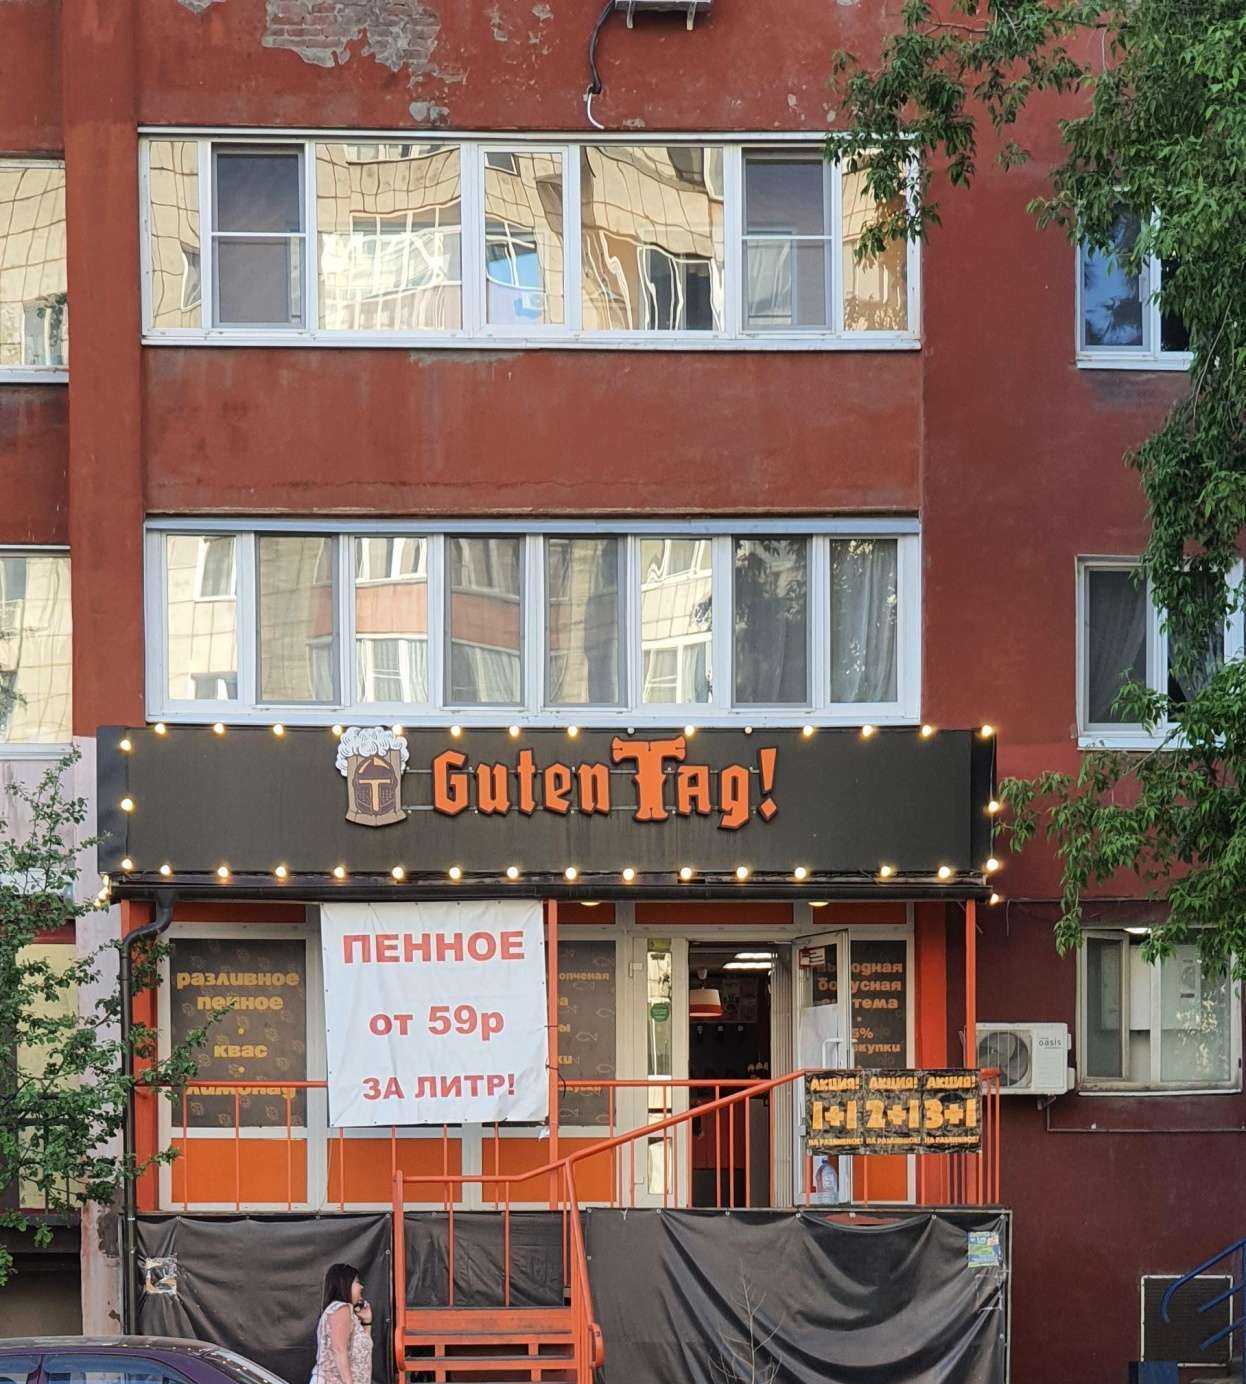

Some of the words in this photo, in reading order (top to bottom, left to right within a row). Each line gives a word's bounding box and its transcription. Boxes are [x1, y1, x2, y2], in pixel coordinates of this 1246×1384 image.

[432, 748, 611, 816] Guten
[343, 930, 525, 964] ПЕННОЕ
[176, 972, 300, 990] разливное
[558, 972, 610, 981] опченая
[197, 996, 284, 1010] пенное
[368, 1012, 414, 1036] от
[428, 1004, 505, 1041] 59р
[213, 1044, 269, 1058] квас
[362, 1076, 405, 1100] ЗА
[415, 1073, 516, 1098] ЛИТР!
[810, 1076, 860, 1091] АКЦИЯ!
[869, 1075, 918, 1090] АКЦИЯ!
[927, 1074, 976, 1089] АКЦИЯ!
[812, 1101, 858, 1130] 1+1
[866, 1099, 920, 1129] 2+1
[924, 1098, 977, 1129] 3+1
